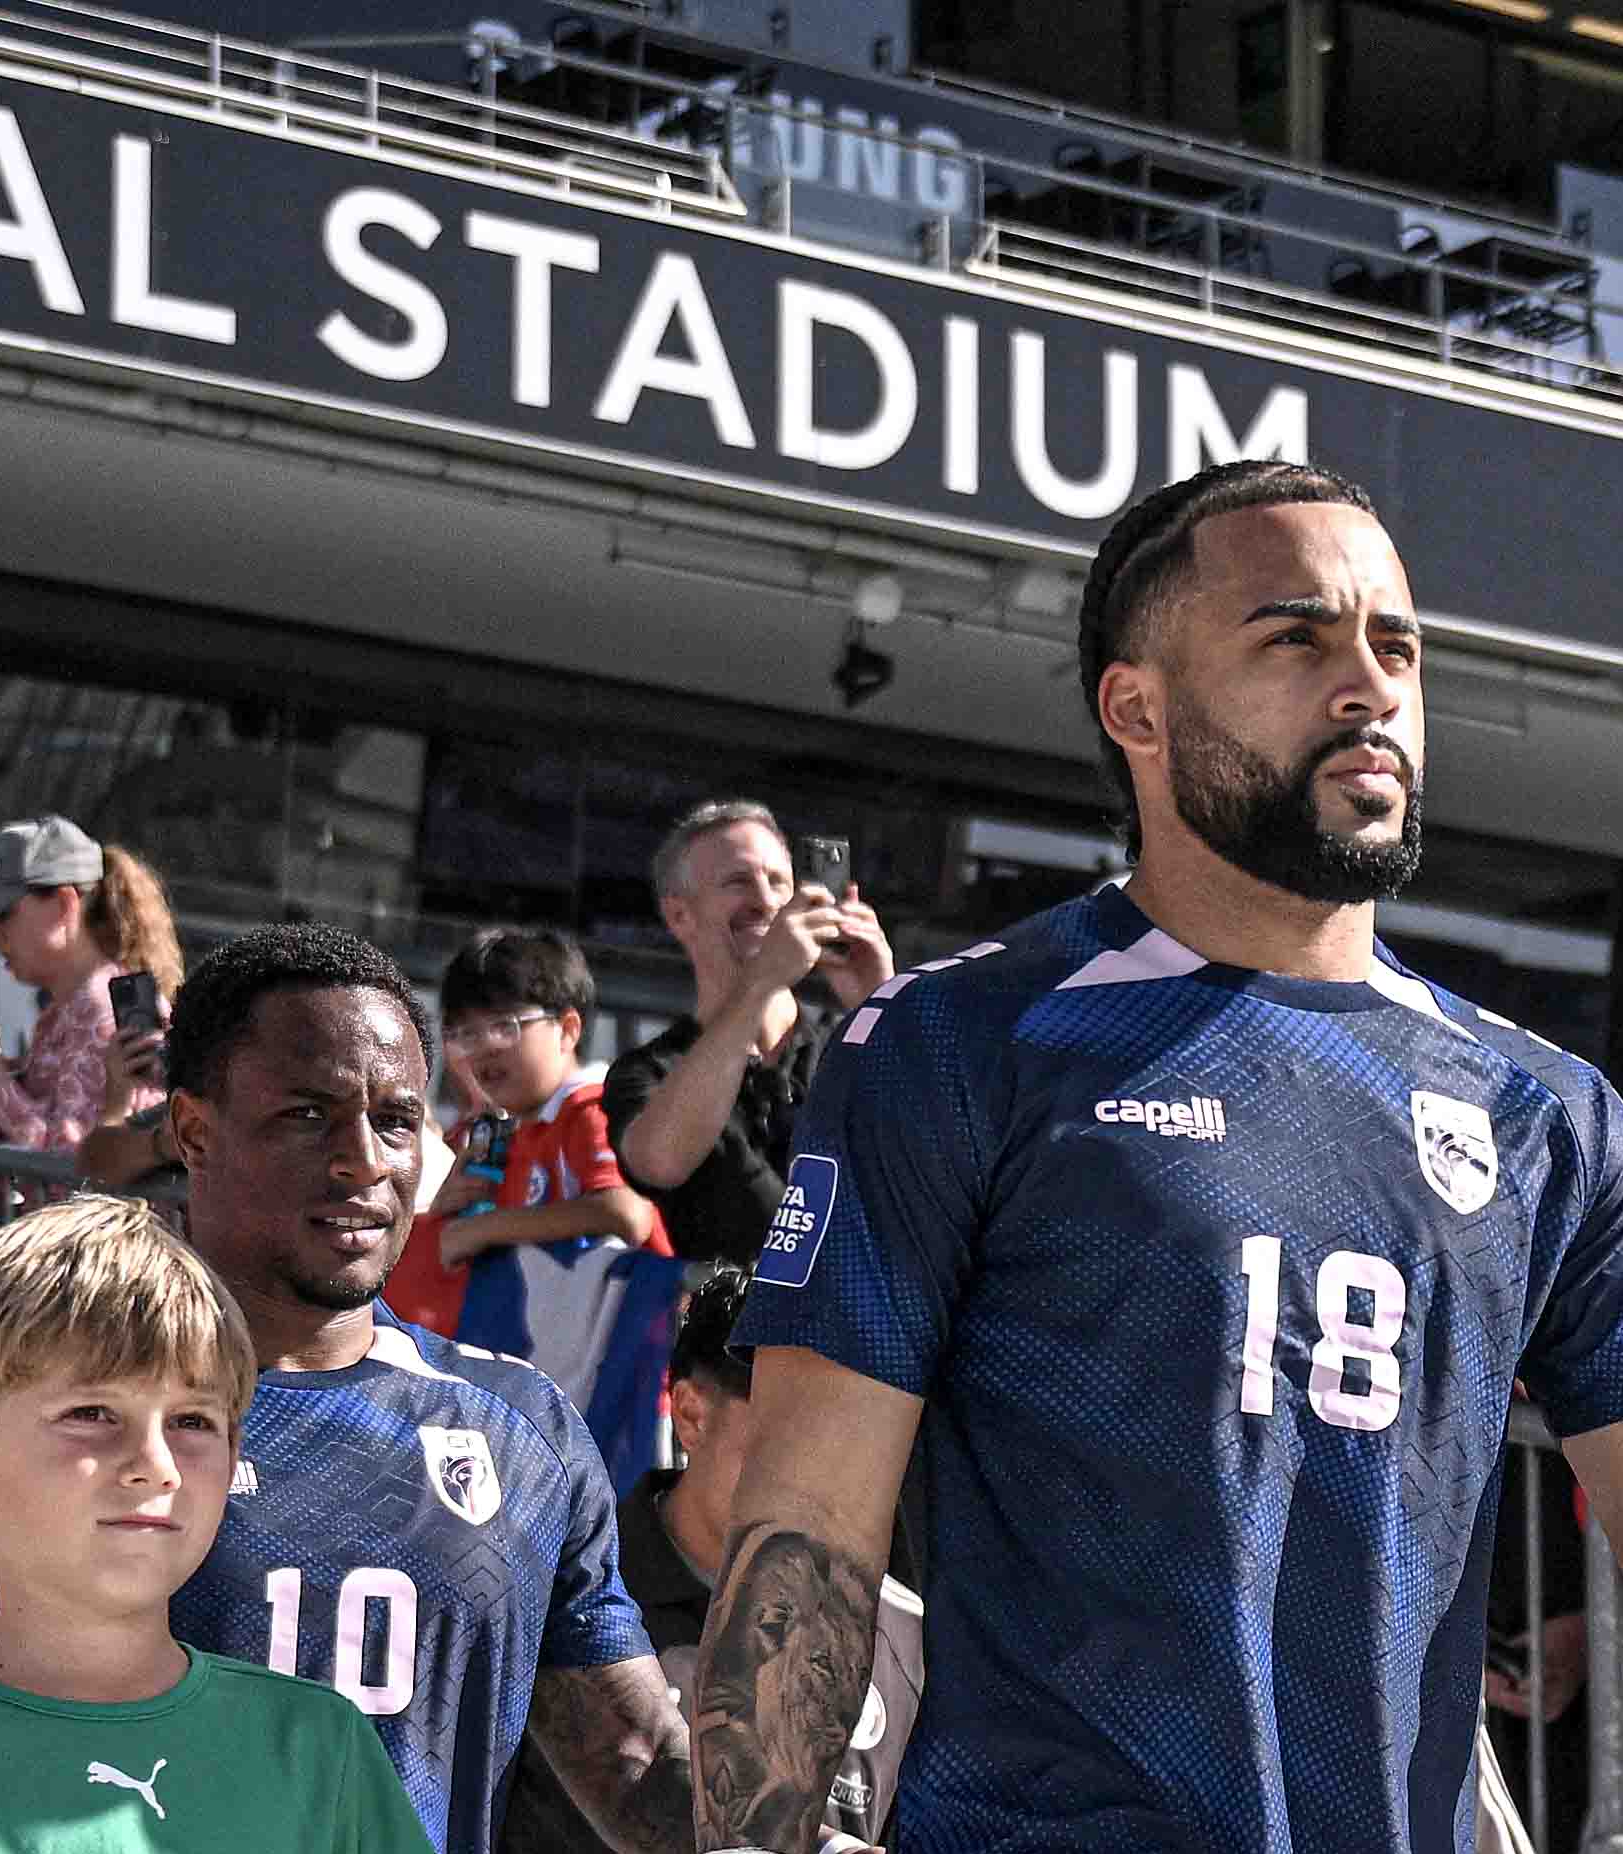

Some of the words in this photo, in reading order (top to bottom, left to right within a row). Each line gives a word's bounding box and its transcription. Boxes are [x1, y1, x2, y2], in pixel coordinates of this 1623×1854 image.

[316, 186, 1310, 519] STADIUM
[1094, 1095, 1226, 1132] capelli
[1159, 1123, 1226, 1143] SPORT
[782, 1186, 804, 1208] FA
[1238, 1233, 1407, 1432] 18
[264, 1566, 417, 1716] 10
